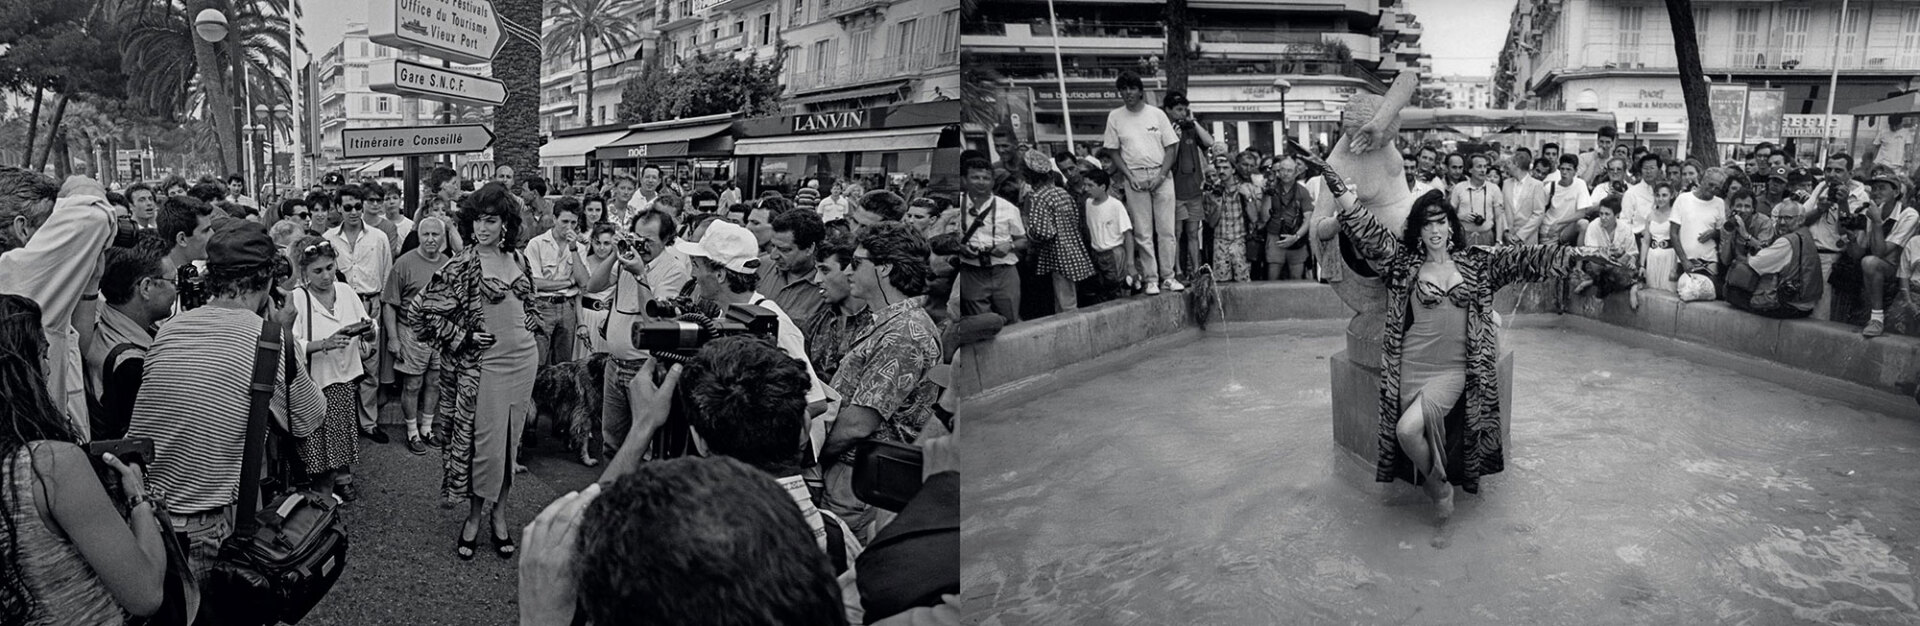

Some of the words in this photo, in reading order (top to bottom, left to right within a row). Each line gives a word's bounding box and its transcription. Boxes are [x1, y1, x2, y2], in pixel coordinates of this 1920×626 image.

[400, 0, 432, 17] Office
[436, 8, 447, 22] du
[452, 12, 487, 35] Tourisme
[431, 24, 456, 43] Vieux
[460, 34, 478, 50] Port
[400, 68, 425, 86] Gare
[429, 73, 467, 93] S.N.C.F.
[794, 110, 864, 132] LANVIN
[350, 137, 405, 150] Itinéraire
[413, 133, 463, 147] Conseillé
[627, 144, 648, 158] noël
